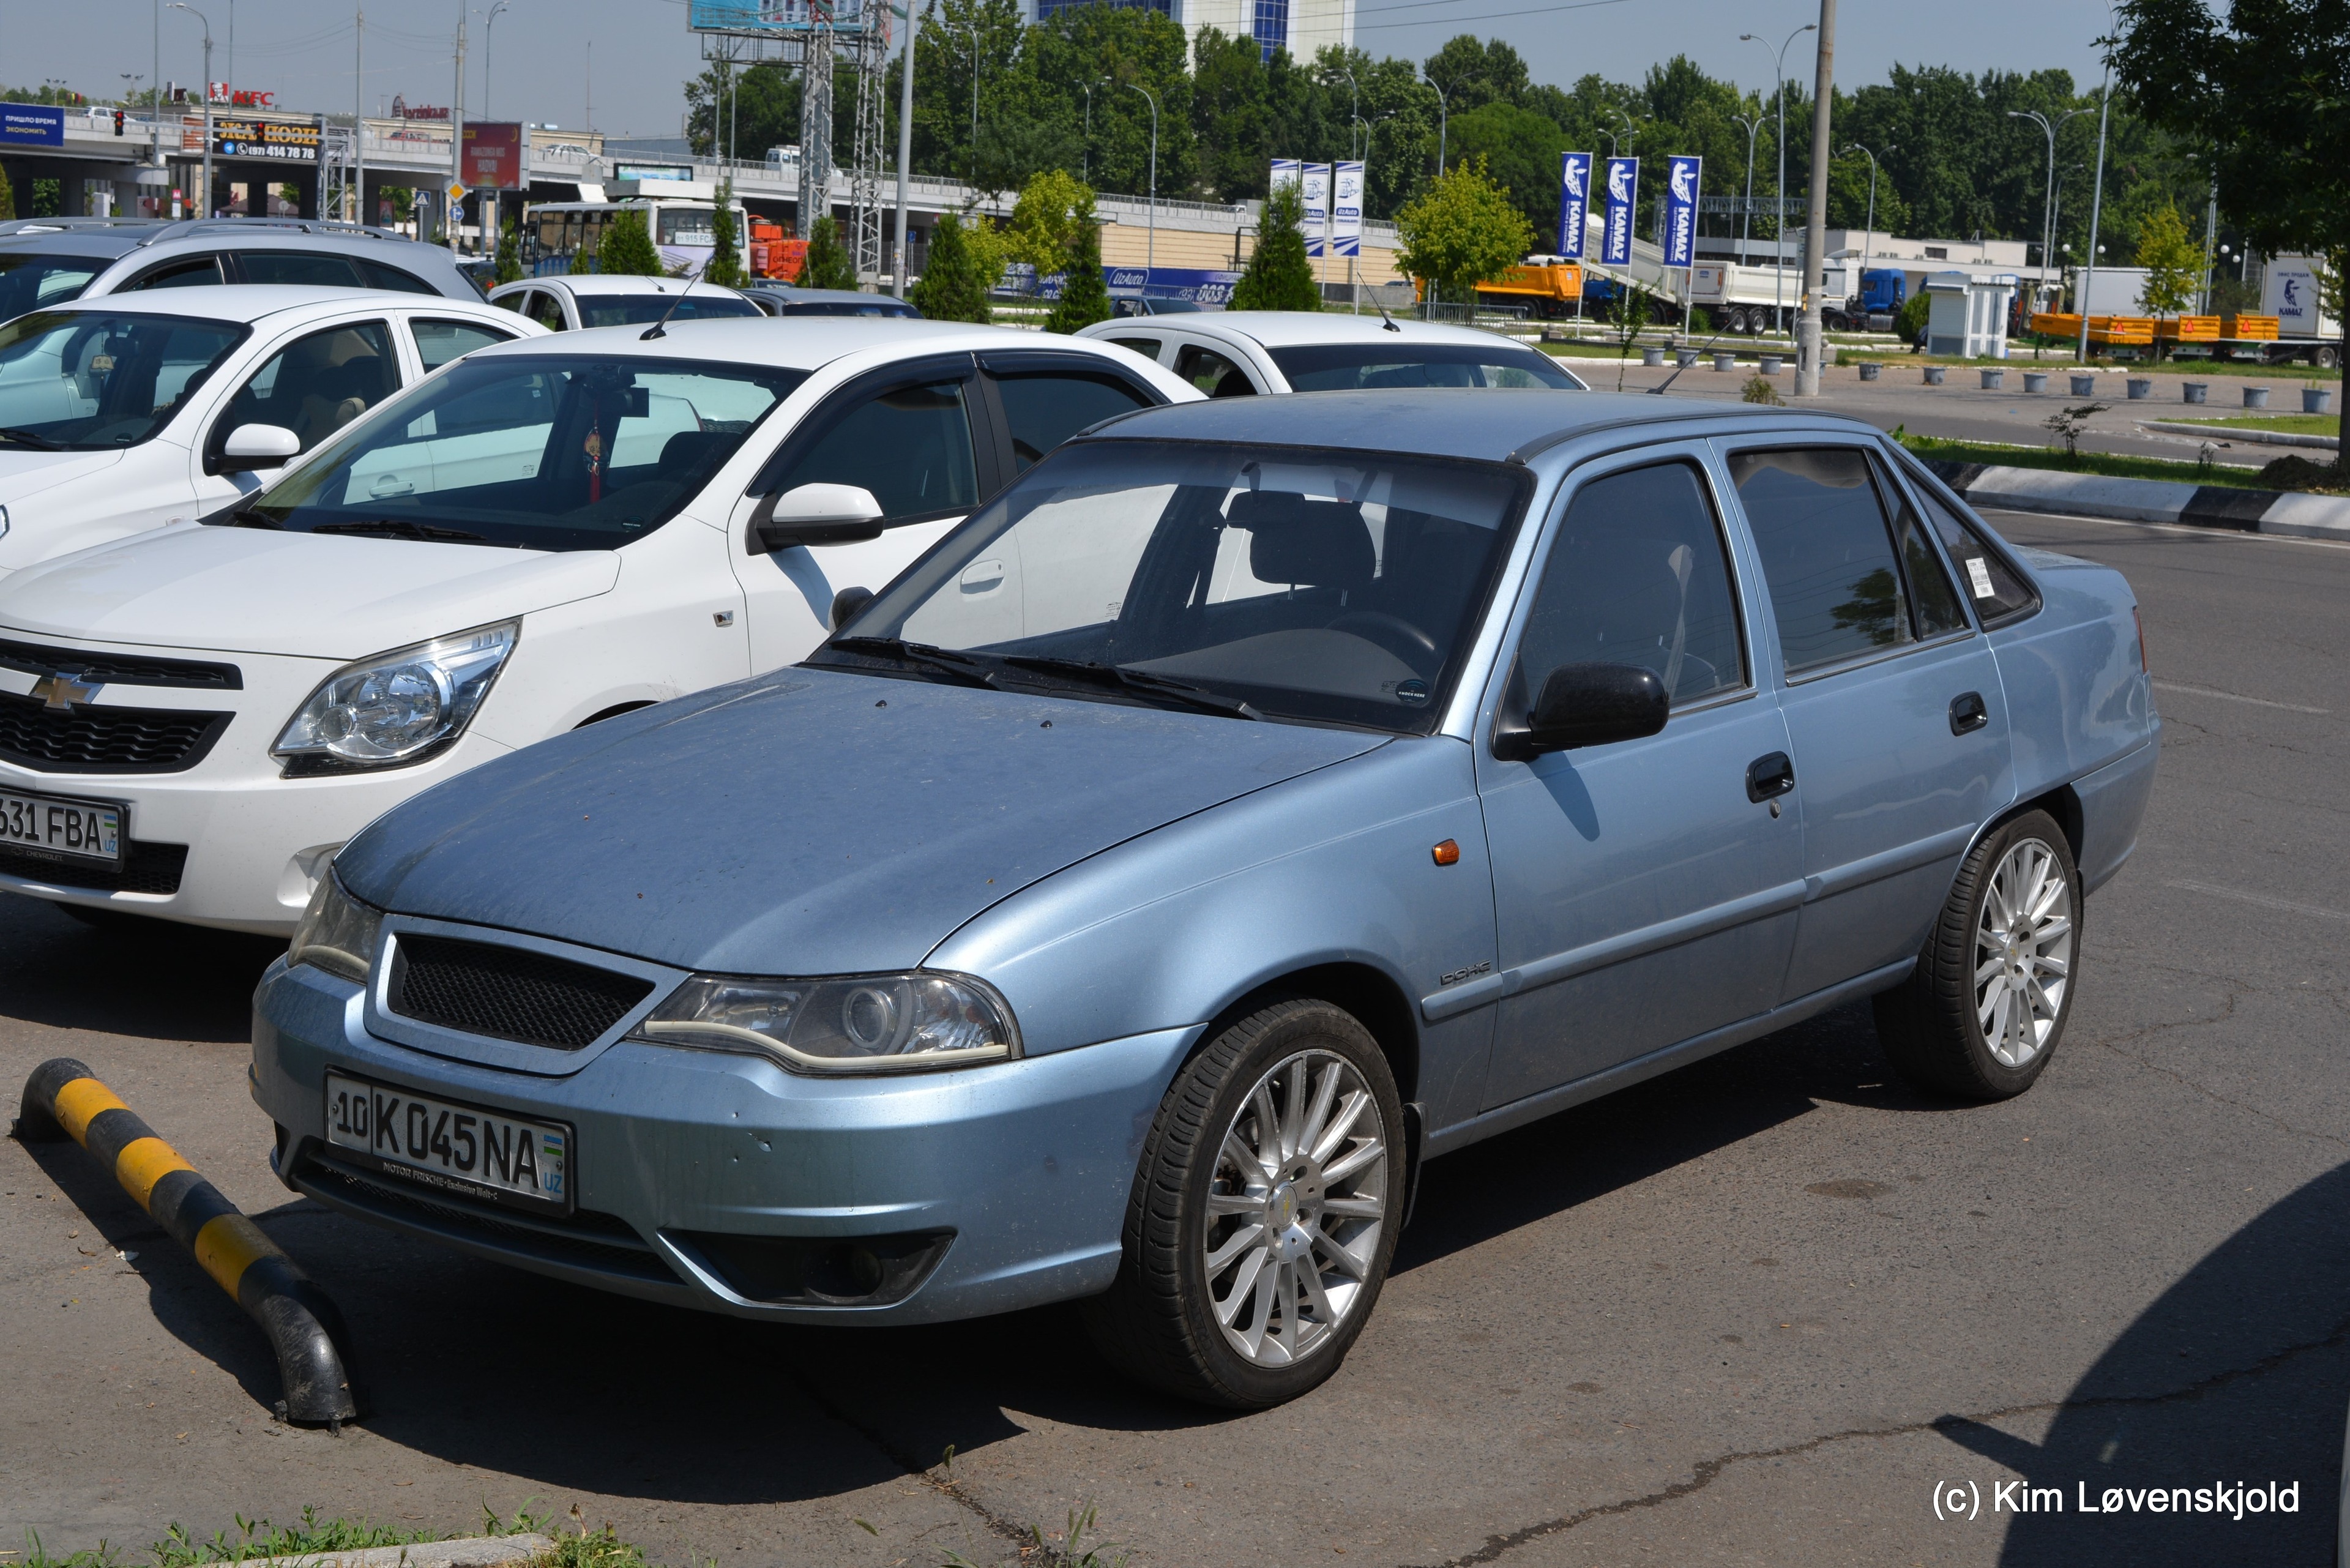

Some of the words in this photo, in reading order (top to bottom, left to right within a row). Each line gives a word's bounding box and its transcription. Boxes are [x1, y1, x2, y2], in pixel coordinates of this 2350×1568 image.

[232, 90, 274, 106] KFC
[6, 126, 47, 135] ЭКОНОМИТЬ
[248, 146, 265, 155] (97)
[266, 146, 286, 157] 414
[287, 146, 300, 158] 78
[302, 148, 315, 159] 78
[1567, 201, 1581, 253] KAMAZ
[1612, 206, 1627, 260] KAMAZ
[1674, 207, 1690, 262] KAMAZ
[1113, 273, 1144, 285] UzAuto
[2278, 307, 2303, 316] KAMAZ
[48, 805, 103, 851] FBA
[105, 839, 117, 853] UZ
[26, 850, 63, 861] CHEVROLET
[337, 1091, 367, 1138] 10
[382, 1162, 411, 1178] MOTOR
[544, 1173, 562, 1194] UZ
